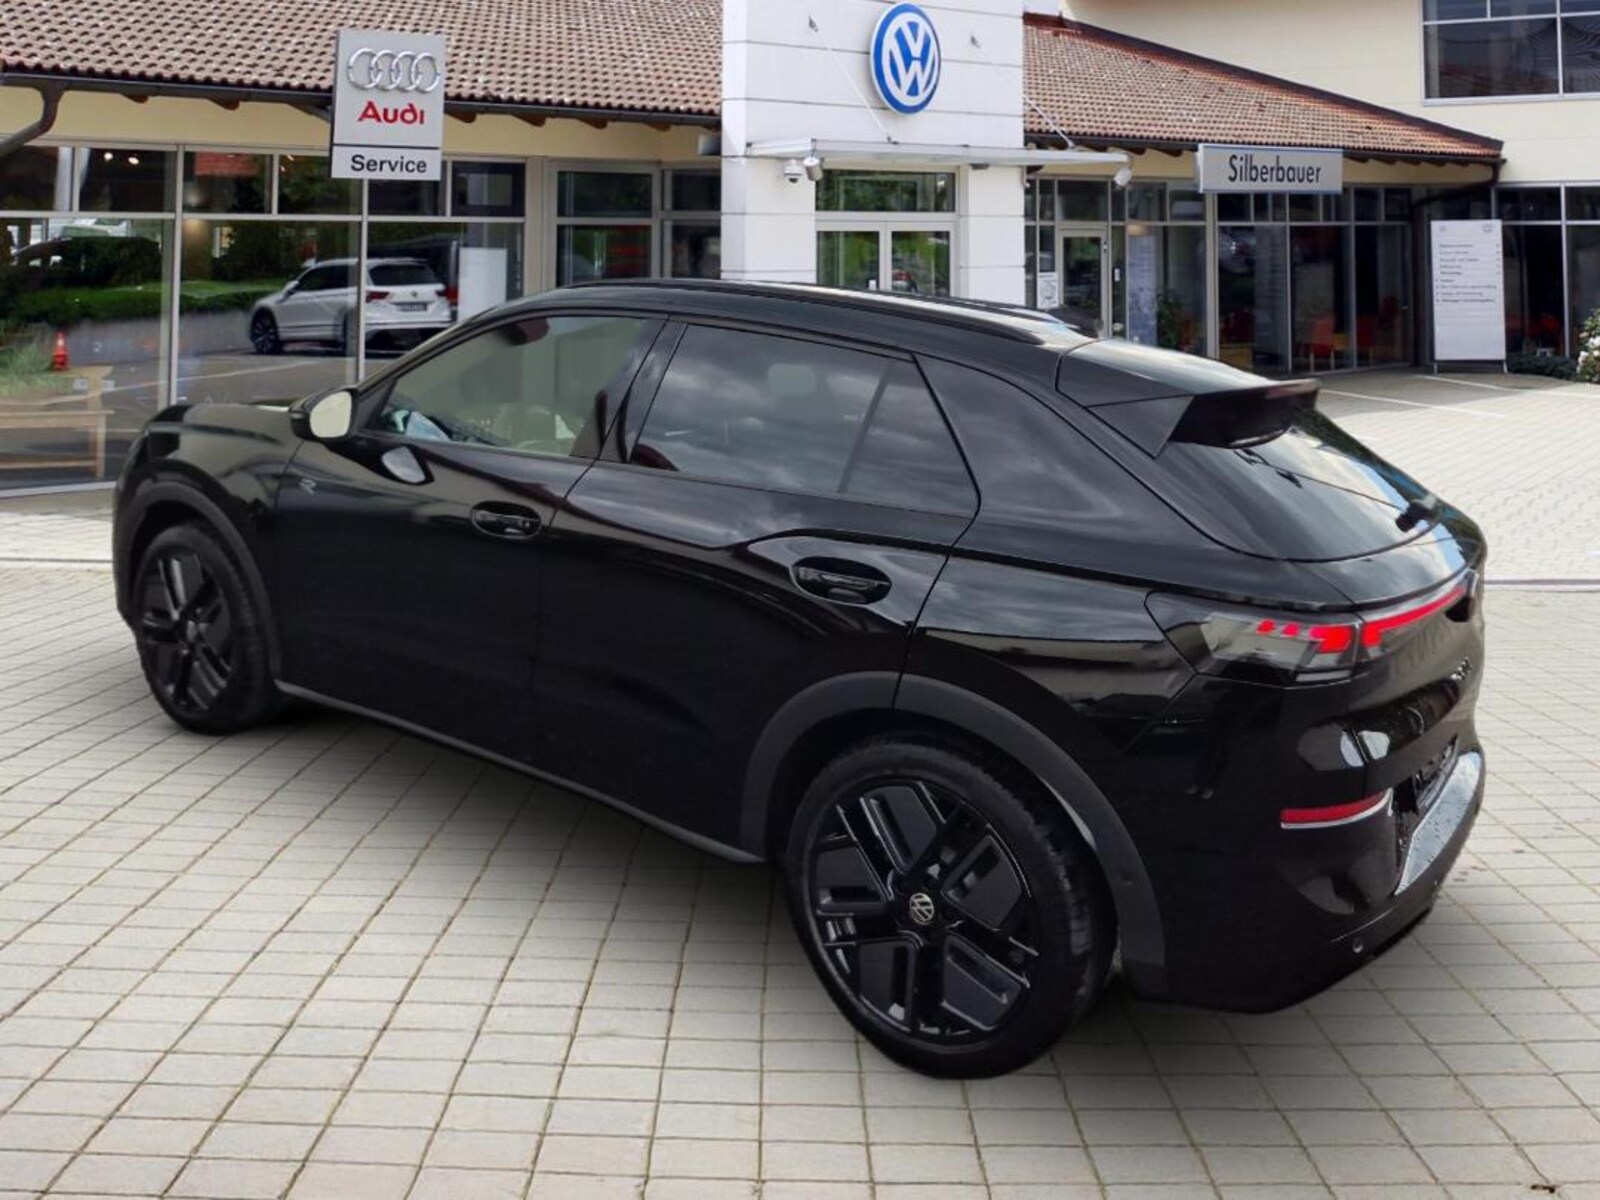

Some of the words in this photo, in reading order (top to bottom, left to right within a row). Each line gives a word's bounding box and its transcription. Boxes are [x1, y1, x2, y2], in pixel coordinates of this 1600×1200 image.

[357, 100, 425, 125] Audi
[350, 154, 427, 173] Service
[1227, 153, 1322, 183] Silberbauer
